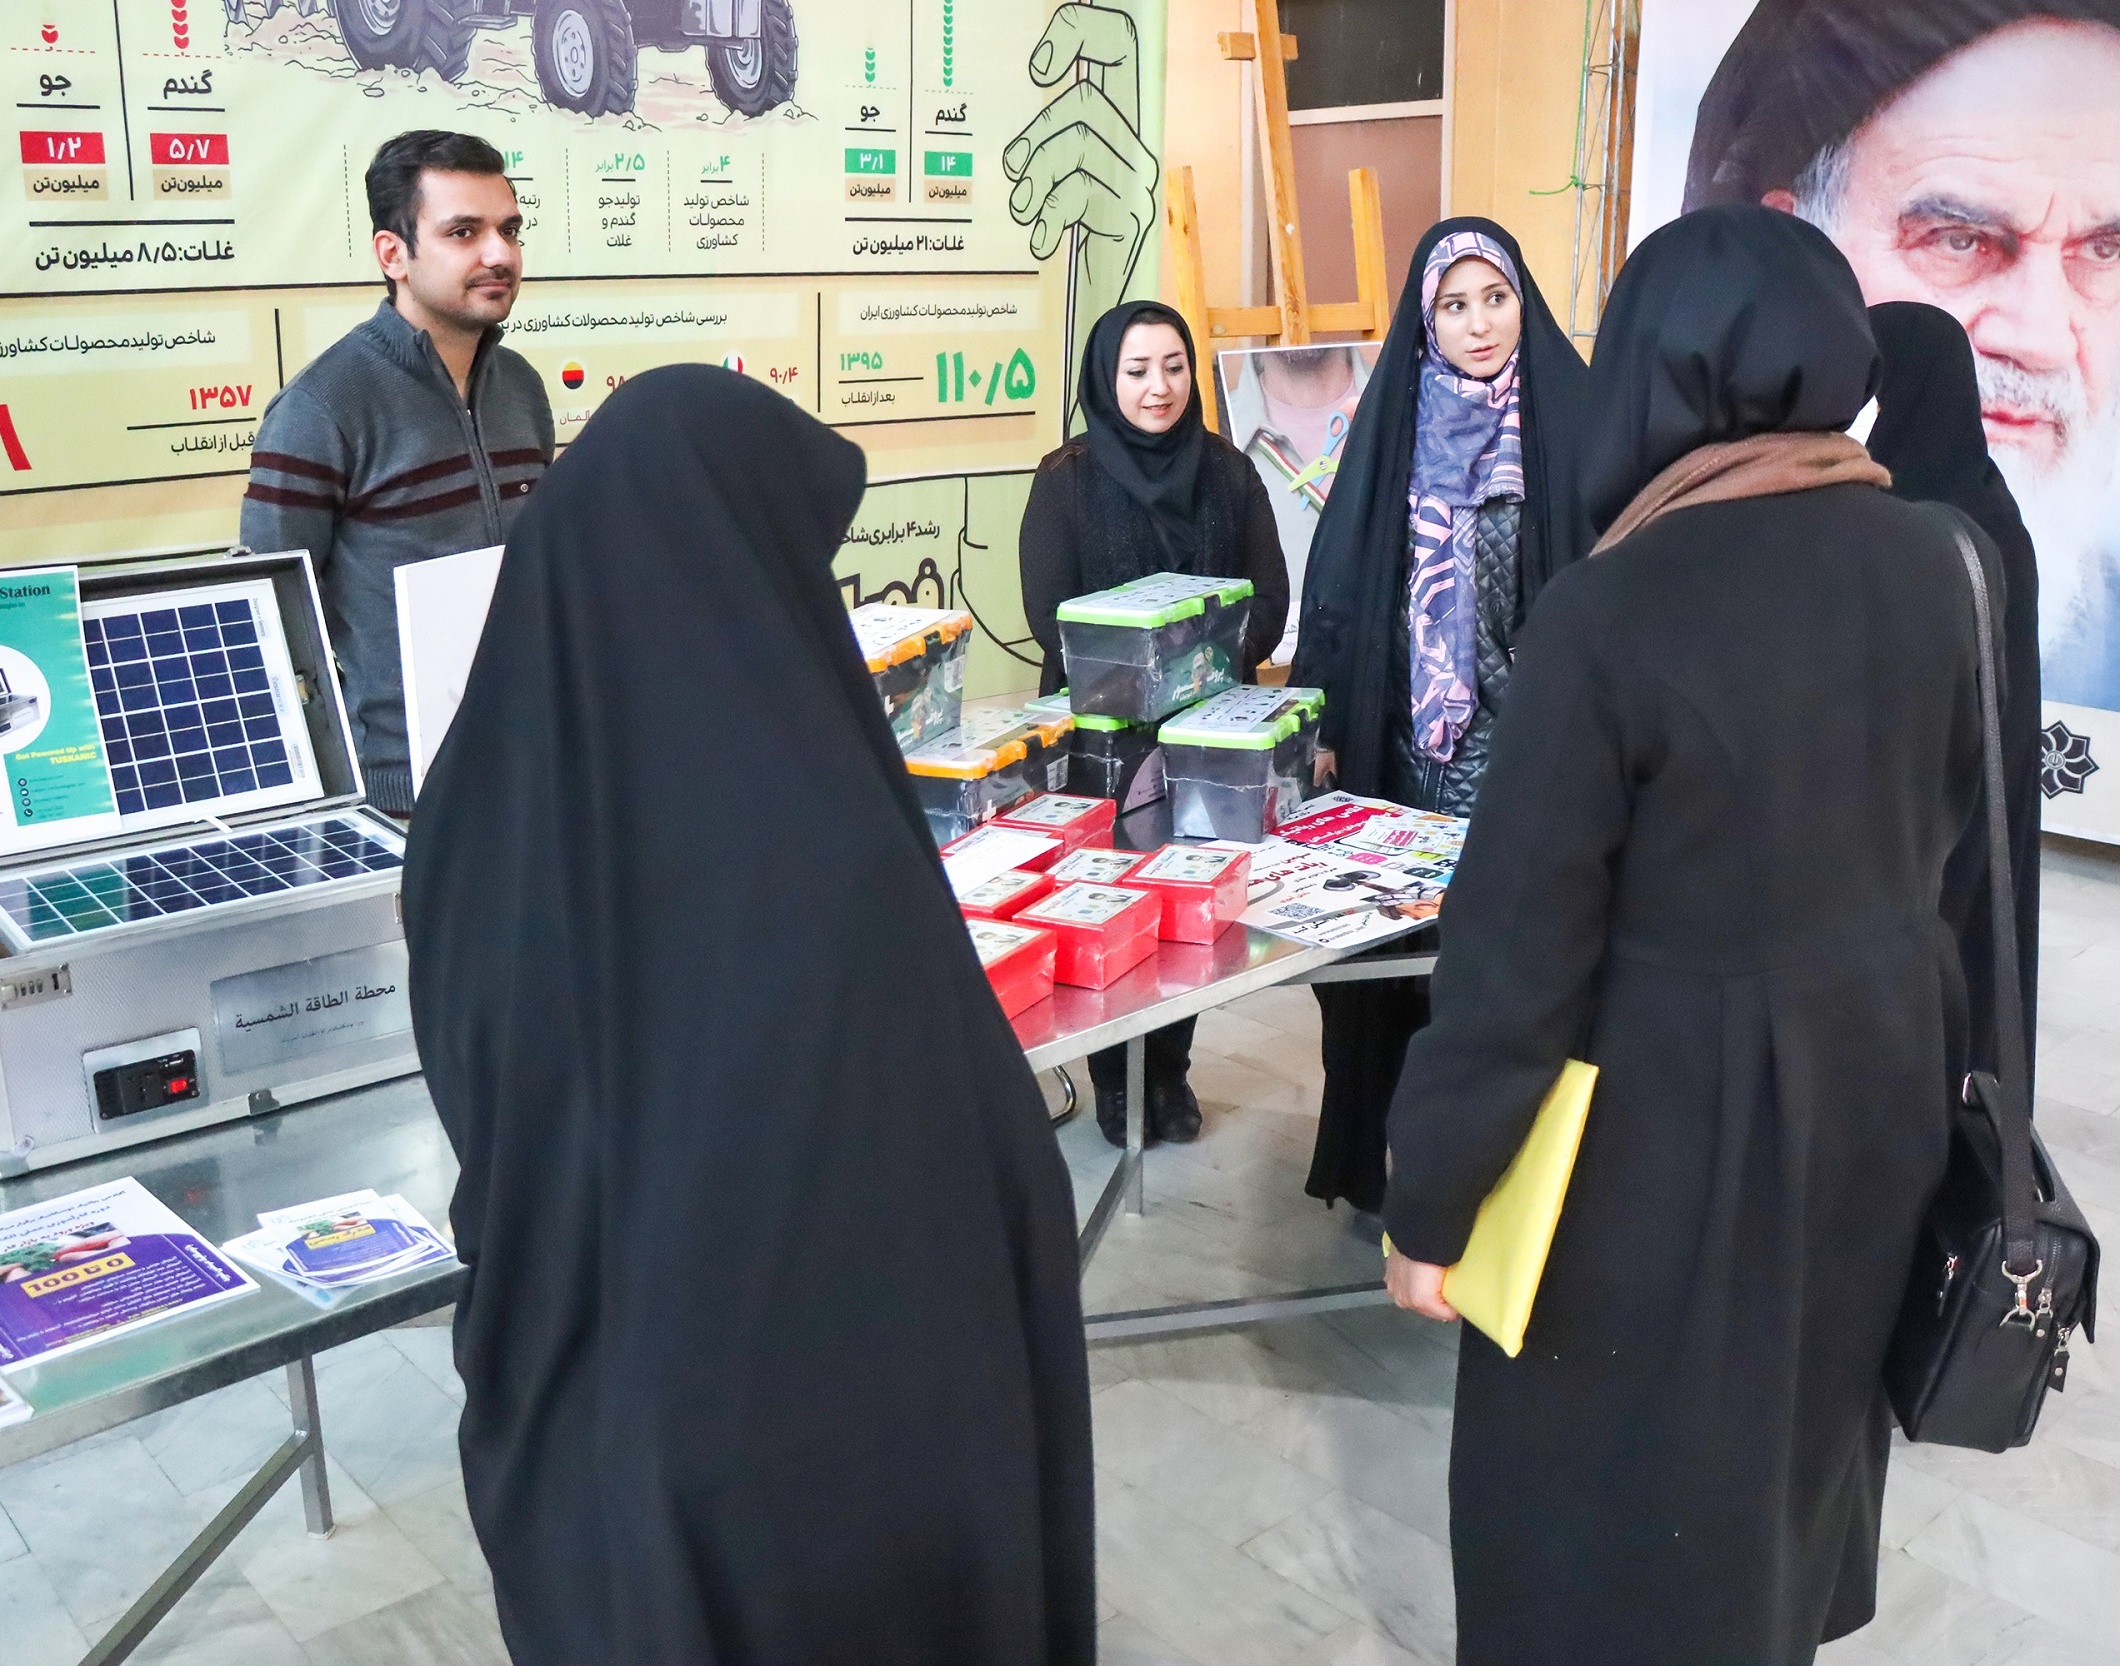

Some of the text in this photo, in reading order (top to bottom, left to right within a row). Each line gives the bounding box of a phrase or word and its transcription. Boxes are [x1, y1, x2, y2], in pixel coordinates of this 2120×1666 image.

[39, 73, 72, 97] جو
[163, 69, 212, 100] گندم
[860, 105, 880, 122] جو
[936, 103, 967, 125] گندم
[596, 160, 614, 174] برابر
[702, 155, 730, 174] ۴ برابر
[941, 156, 956, 171] ۱۴
[33, 174, 100, 193] میلیون تن
[161, 174, 222, 192] میلیون تن
[519, 194, 540, 208] رتبه
[598, 192, 640, 208] تولید جو
[684, 194, 750, 208] شاخص تولید
[526, 217, 538, 230] در
[602, 212, 636, 229] گندم و
[689, 214, 744, 228] محصولات
[606, 234, 632, 246] غلات
[697, 234, 738, 249] کشاورزی
[853, 237, 869, 254] تن
[870, 235, 914, 254] میلیون
[36, 247, 60, 270] تن
[62, 243, 134, 269] میلیون
[628, 312, 655, 328] تولید
[656, 310, 695, 326] شاخص
[696, 314, 727, 326] بررسی
[860, 304, 1018, 320] شاخص تولید محصولات کشاورزی ایران
[511, 319, 522, 332] در
[524, 314, 571, 332] کشاورزی
[572, 314, 627, 329] محصولات
[50, 335, 130, 354] محصولات
[131, 332, 163, 351] تولید
[165, 329, 216, 349] شاخص
[840, 352, 882, 371] ۱۳۹۵
[190, 385, 252, 410] ۱۳۵۷
[842, 391, 896, 406] بعد از انقلاب
[171, 432, 255, 455] قبل از انقلاب
[868, 523, 904, 545] برابری
[907, 521, 916, 537] ۴
[916, 520, 940, 538] رشد
[236, 984, 396, 1032] محطة الطاقة الشمسية
